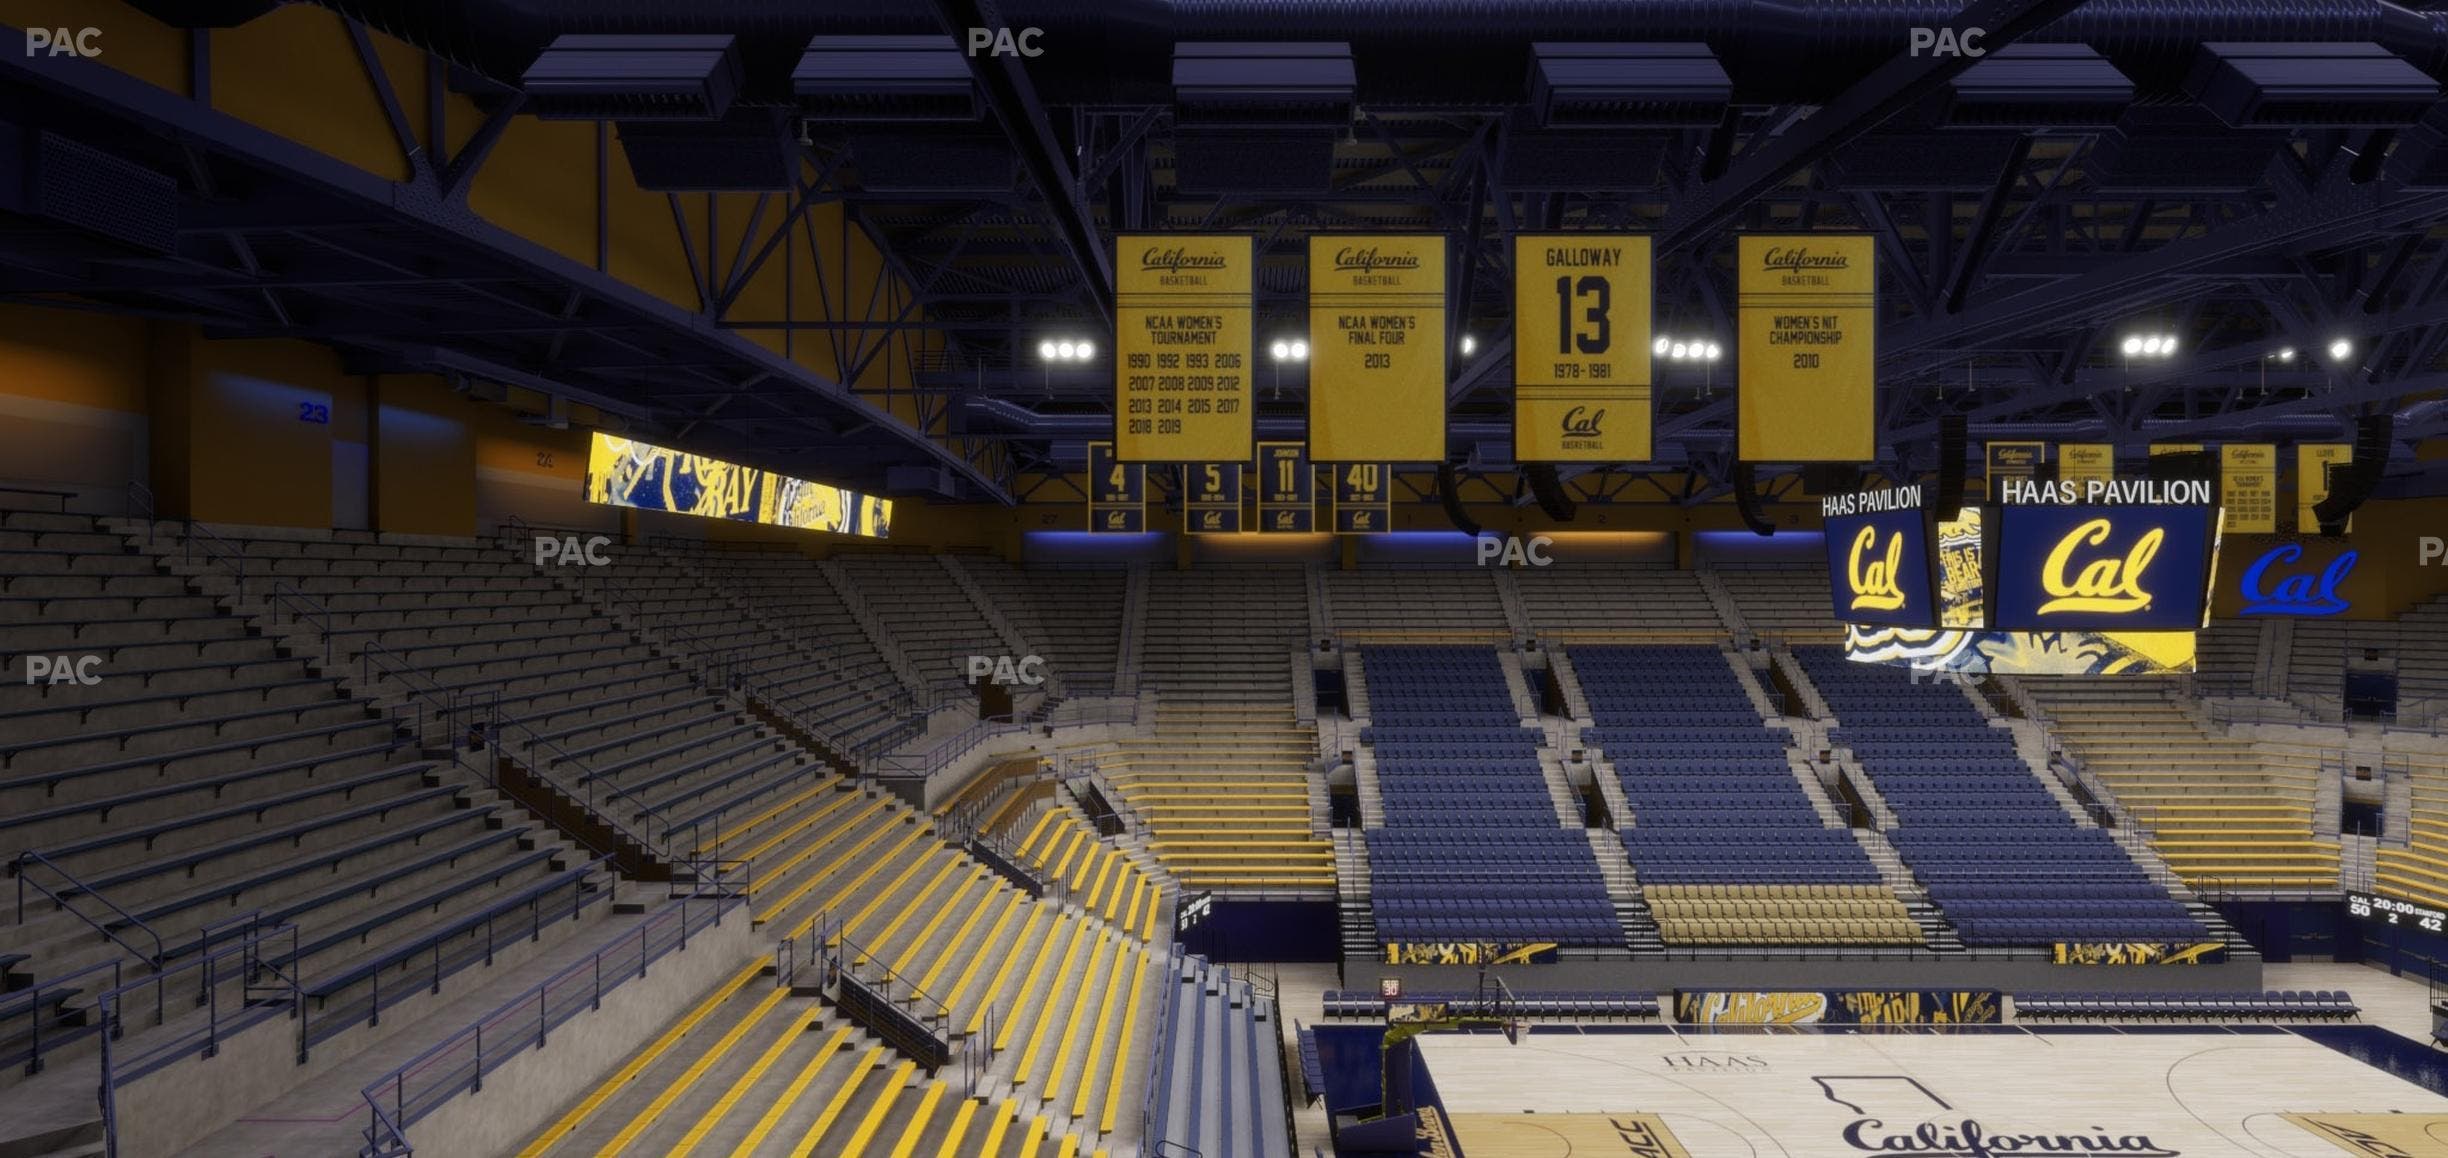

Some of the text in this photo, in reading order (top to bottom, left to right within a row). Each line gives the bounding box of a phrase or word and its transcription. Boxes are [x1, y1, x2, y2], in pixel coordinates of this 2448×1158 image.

[1141, 246, 1227, 273] California
[1333, 246, 1420, 273] California
[1546, 247, 1622, 267] GALLOWAY
[1762, 247, 1850, 273] California
[1159, 275, 1208, 286] BASKETBALL
[1352, 275, 1401, 286] BASKETBALL
[1781, 275, 1830, 286] BASKETBALL
[1145, 316, 1222, 330] NCAA WOMEN'S
[1338, 316, 1415, 330] NCAA WOMEN'S
[1556, 276, 1611, 355] 13
[1774, 315, 1838, 330] WOMEN'S NIT
[1151, 331, 1217, 345] TOURNAMENT
[1348, 331, 1405, 345] FINAL FOUR
[1769, 331, 1842, 345] CHAMPIONSHIP
[1127, 353, 1241, 369] 1990 1992 1993 2006
[1364, 353, 1391, 369] 2013
[1793, 353, 1820, 369] 2010
[1129, 376, 1240, 391] 2007 2008 2009 2012
[300, 402, 329, 424] 23
[1128, 398, 1240, 414] 2013 2014 2015 2017
[1128, 419, 1182, 435] 2018 2019
[1560, 405, 1606, 438] Cal
[1561, 440, 1604, 450] BASKETBALL
[1109, 464, 1125, 492] 4
[1205, 464, 1221, 492] 5
[1278, 460, 1294, 493] 11
[1346, 464, 1378, 492] 40
[1822, 484, 1921, 517] HAAS PAVILION
[2002, 480, 2210, 504] HAAS PAVILION
[1849, 525, 1905, 611] Cal
[2037, 518, 2166, 616] Cal
[2239, 543, 2359, 616] Cal
[2349, 895, 2371, 906] CAL
[2373, 897, 2414, 915] 20:00
[2350, 903, 2442, 932] 50 2 42
[1842, 1118, 2182, 1158] California
